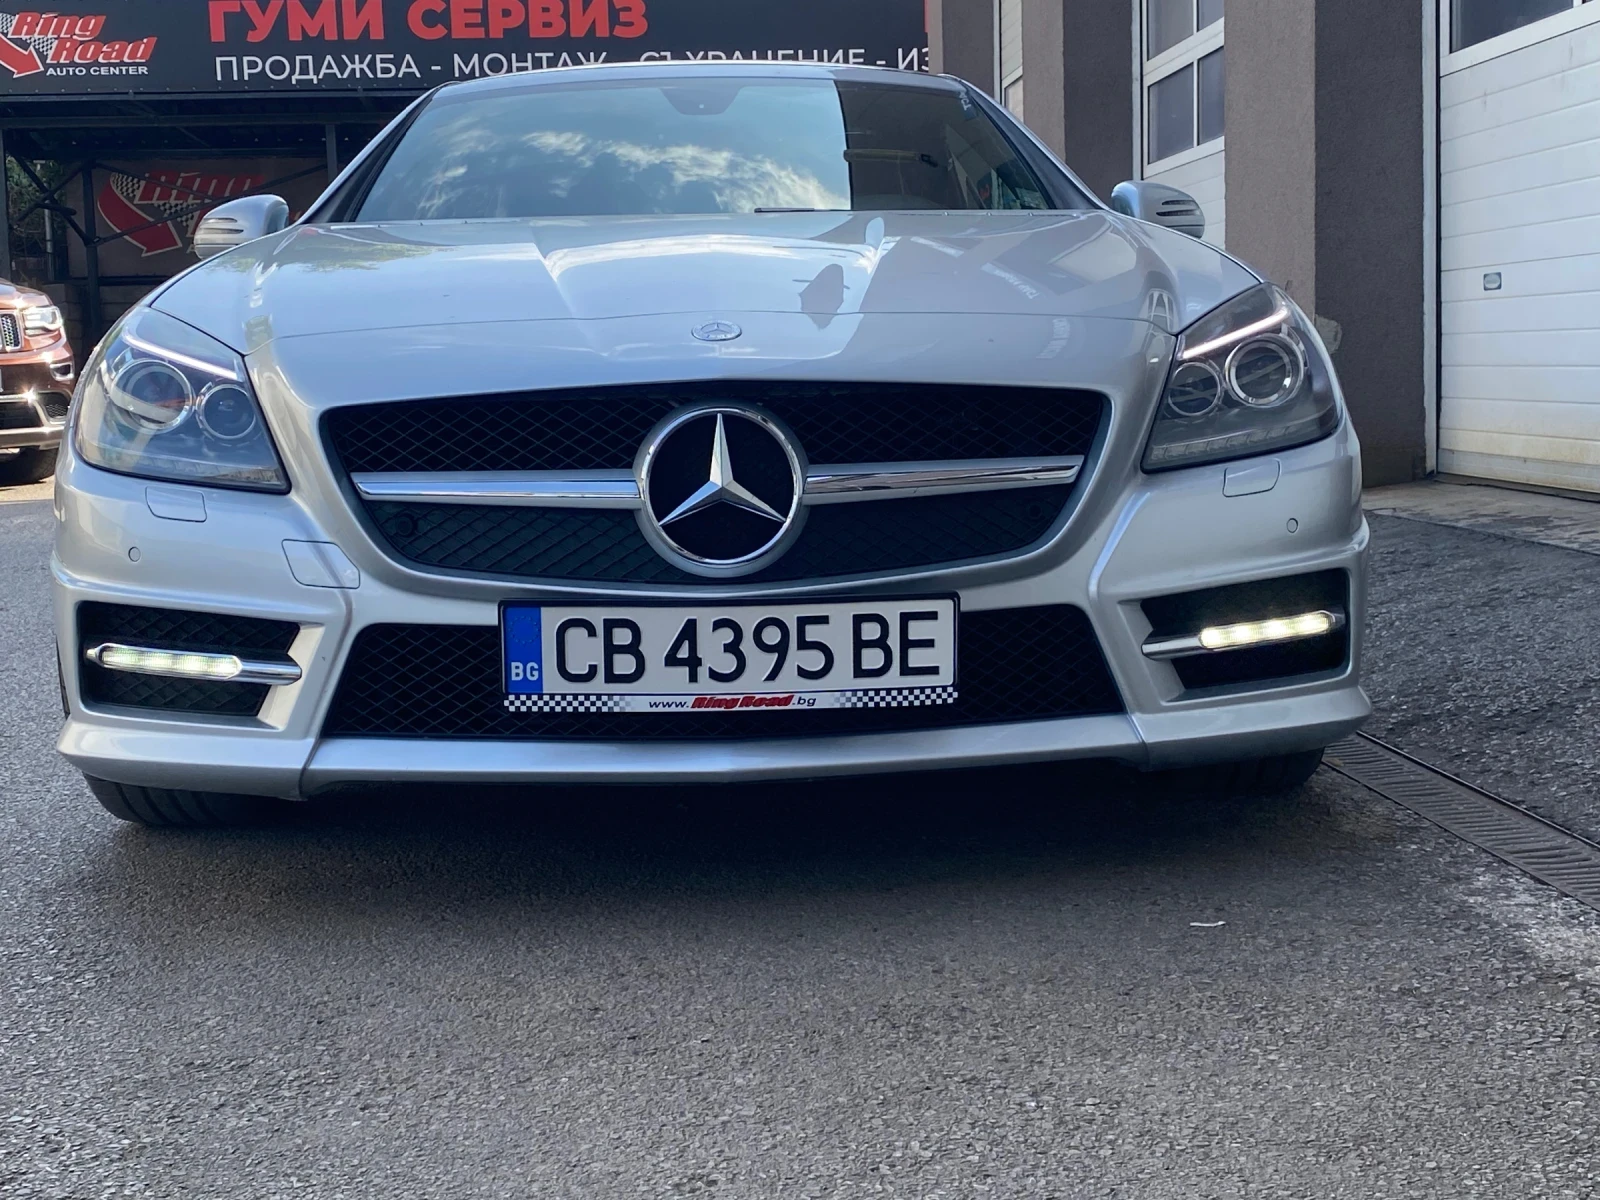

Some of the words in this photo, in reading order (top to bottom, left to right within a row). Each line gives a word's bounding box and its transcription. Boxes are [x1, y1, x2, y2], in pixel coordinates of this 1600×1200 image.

[8, 12, 106, 40] Ring
[209, 0, 385, 42] ГУМИ
[407, 0, 648, 40] СЕРВИЗ
[46, 37, 157, 63] Road
[46, 67, 86, 76] AUTO
[90, 66, 148, 75] CENTER
[215, 54, 421, 84] ПРОДАЖБА
[555, 617, 646, 684] CB
[664, 615, 835, 683] 4395
[852, 611, 940, 679] BE
[511, 662, 539, 681] BG
